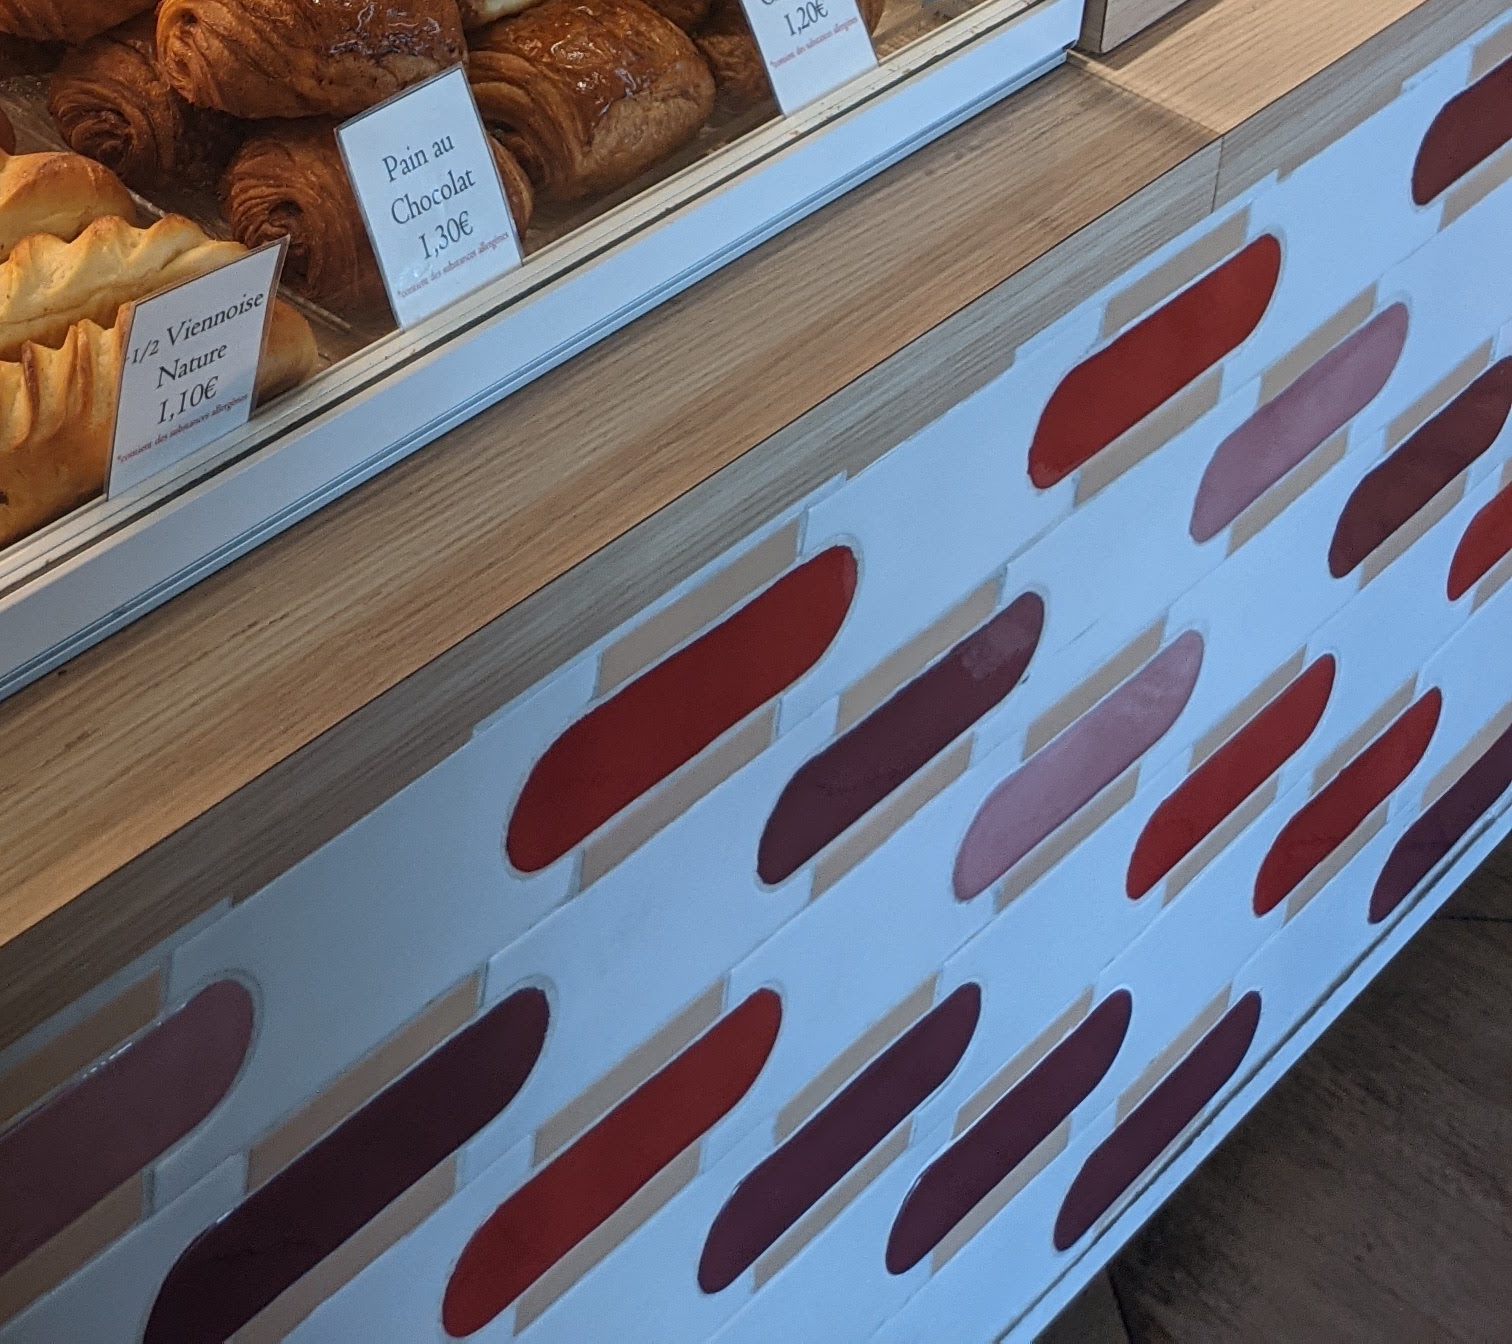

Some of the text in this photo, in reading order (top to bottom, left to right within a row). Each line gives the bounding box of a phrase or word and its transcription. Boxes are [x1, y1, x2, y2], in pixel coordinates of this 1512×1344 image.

[382, 135, 455, 183] Pain au
[391, 169, 476, 225] Chocolat
[419, 210, 474, 260] 1,30€
[166, 293, 264, 346] Viennoise
[155, 344, 228, 389] Nature
[157, 375, 219, 425] 1,10€
